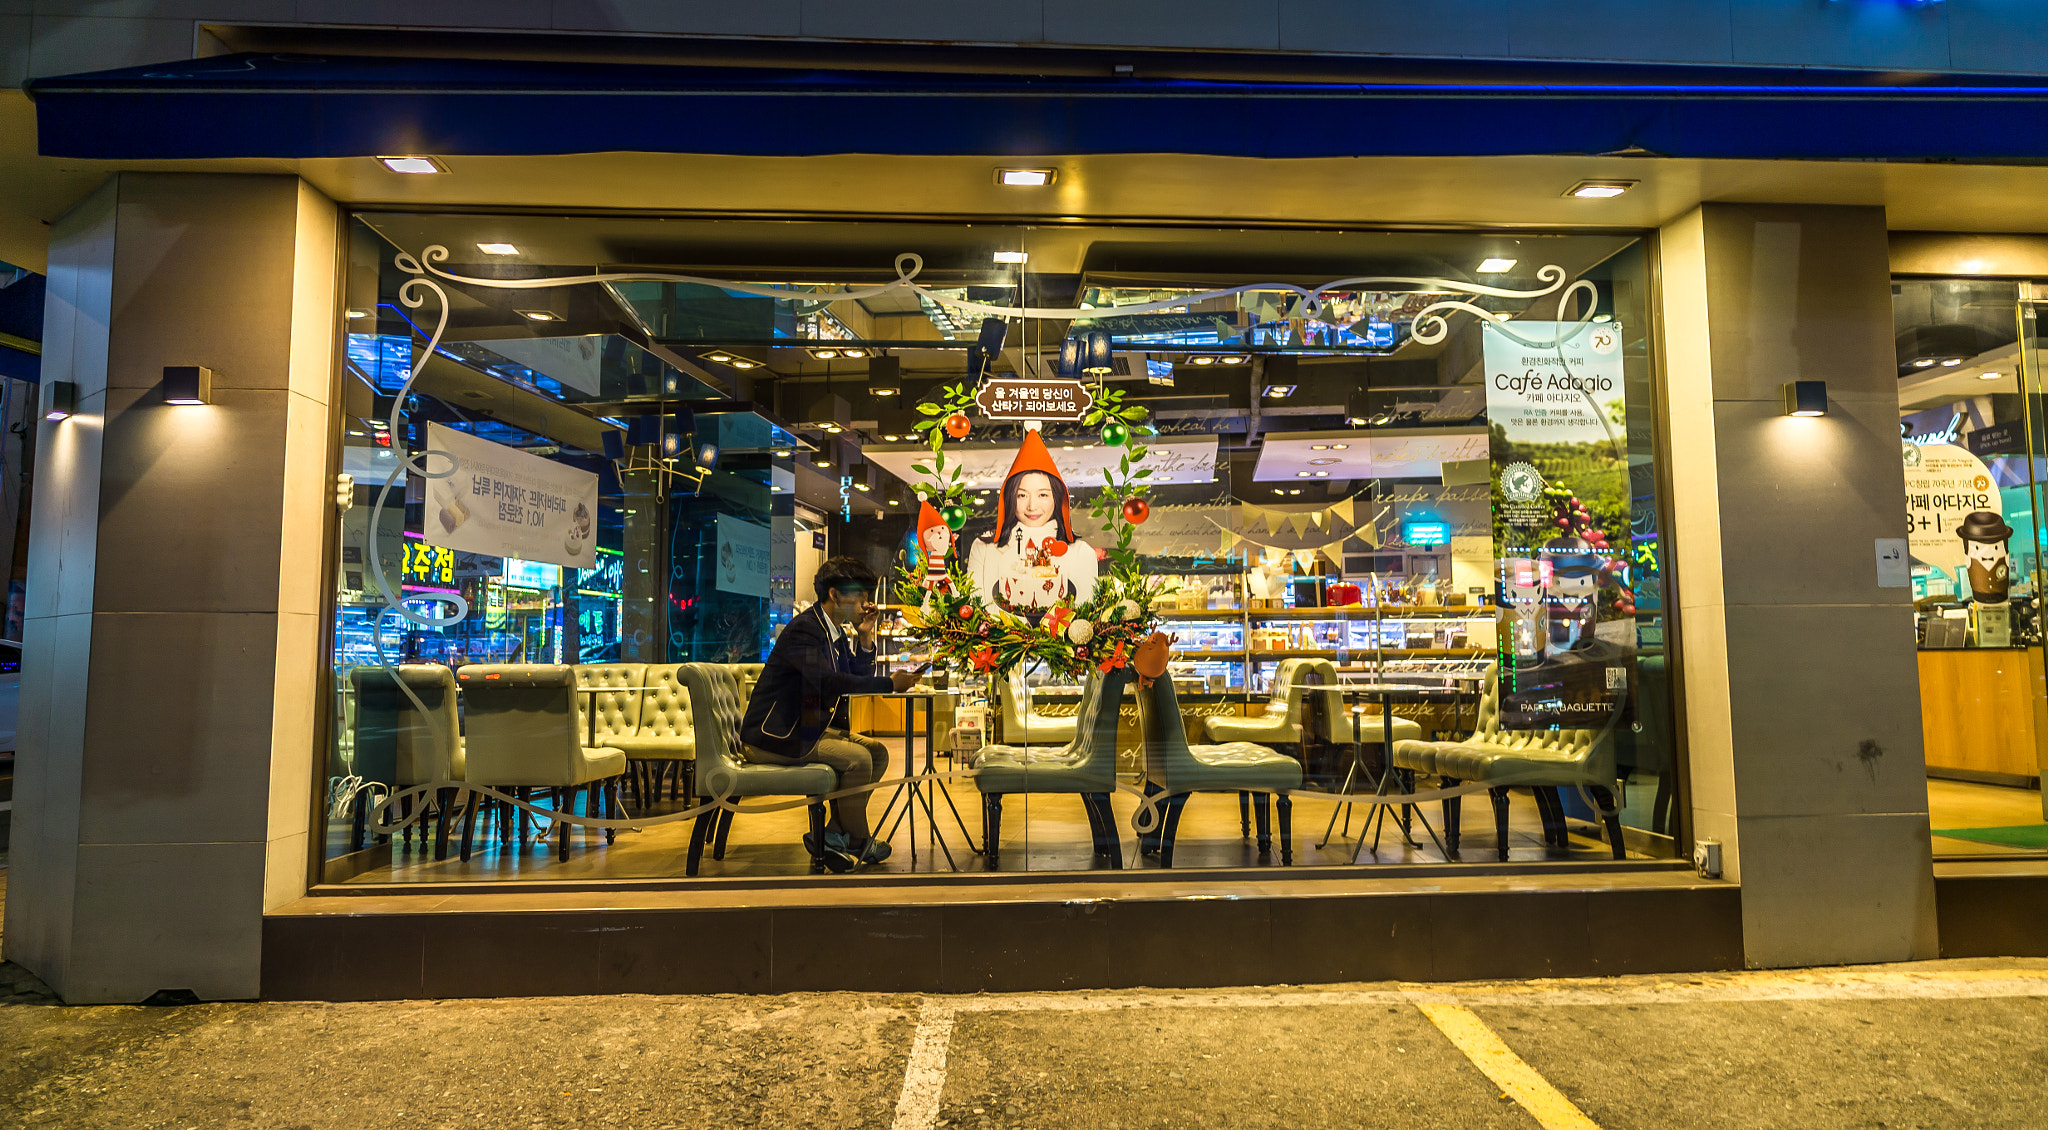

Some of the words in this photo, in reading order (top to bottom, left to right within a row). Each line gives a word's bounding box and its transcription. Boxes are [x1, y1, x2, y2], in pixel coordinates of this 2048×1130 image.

[1568, 356, 1585, 367] 커피
[1494, 369, 1543, 396] Café
[1546, 373, 1613, 395] Adagio
[1008, 386, 1040, 400] 겨울엔
[1042, 387, 1073, 400] 당신이
[1526, 393, 1544, 403] 카페
[1546, 393, 1582, 403] 아다지오
[991, 400, 1023, 413] 산타가
[1025, 400, 1077, 413] 되어보세요
[1523, 408, 1533, 417] RA
[1905, 479, 1931, 489] PC창립
[1932, 479, 1956, 489] 70주년
[1933, 493, 1991, 511] 아다지오
[1559, 702, 1615, 713] BAGUETTE
